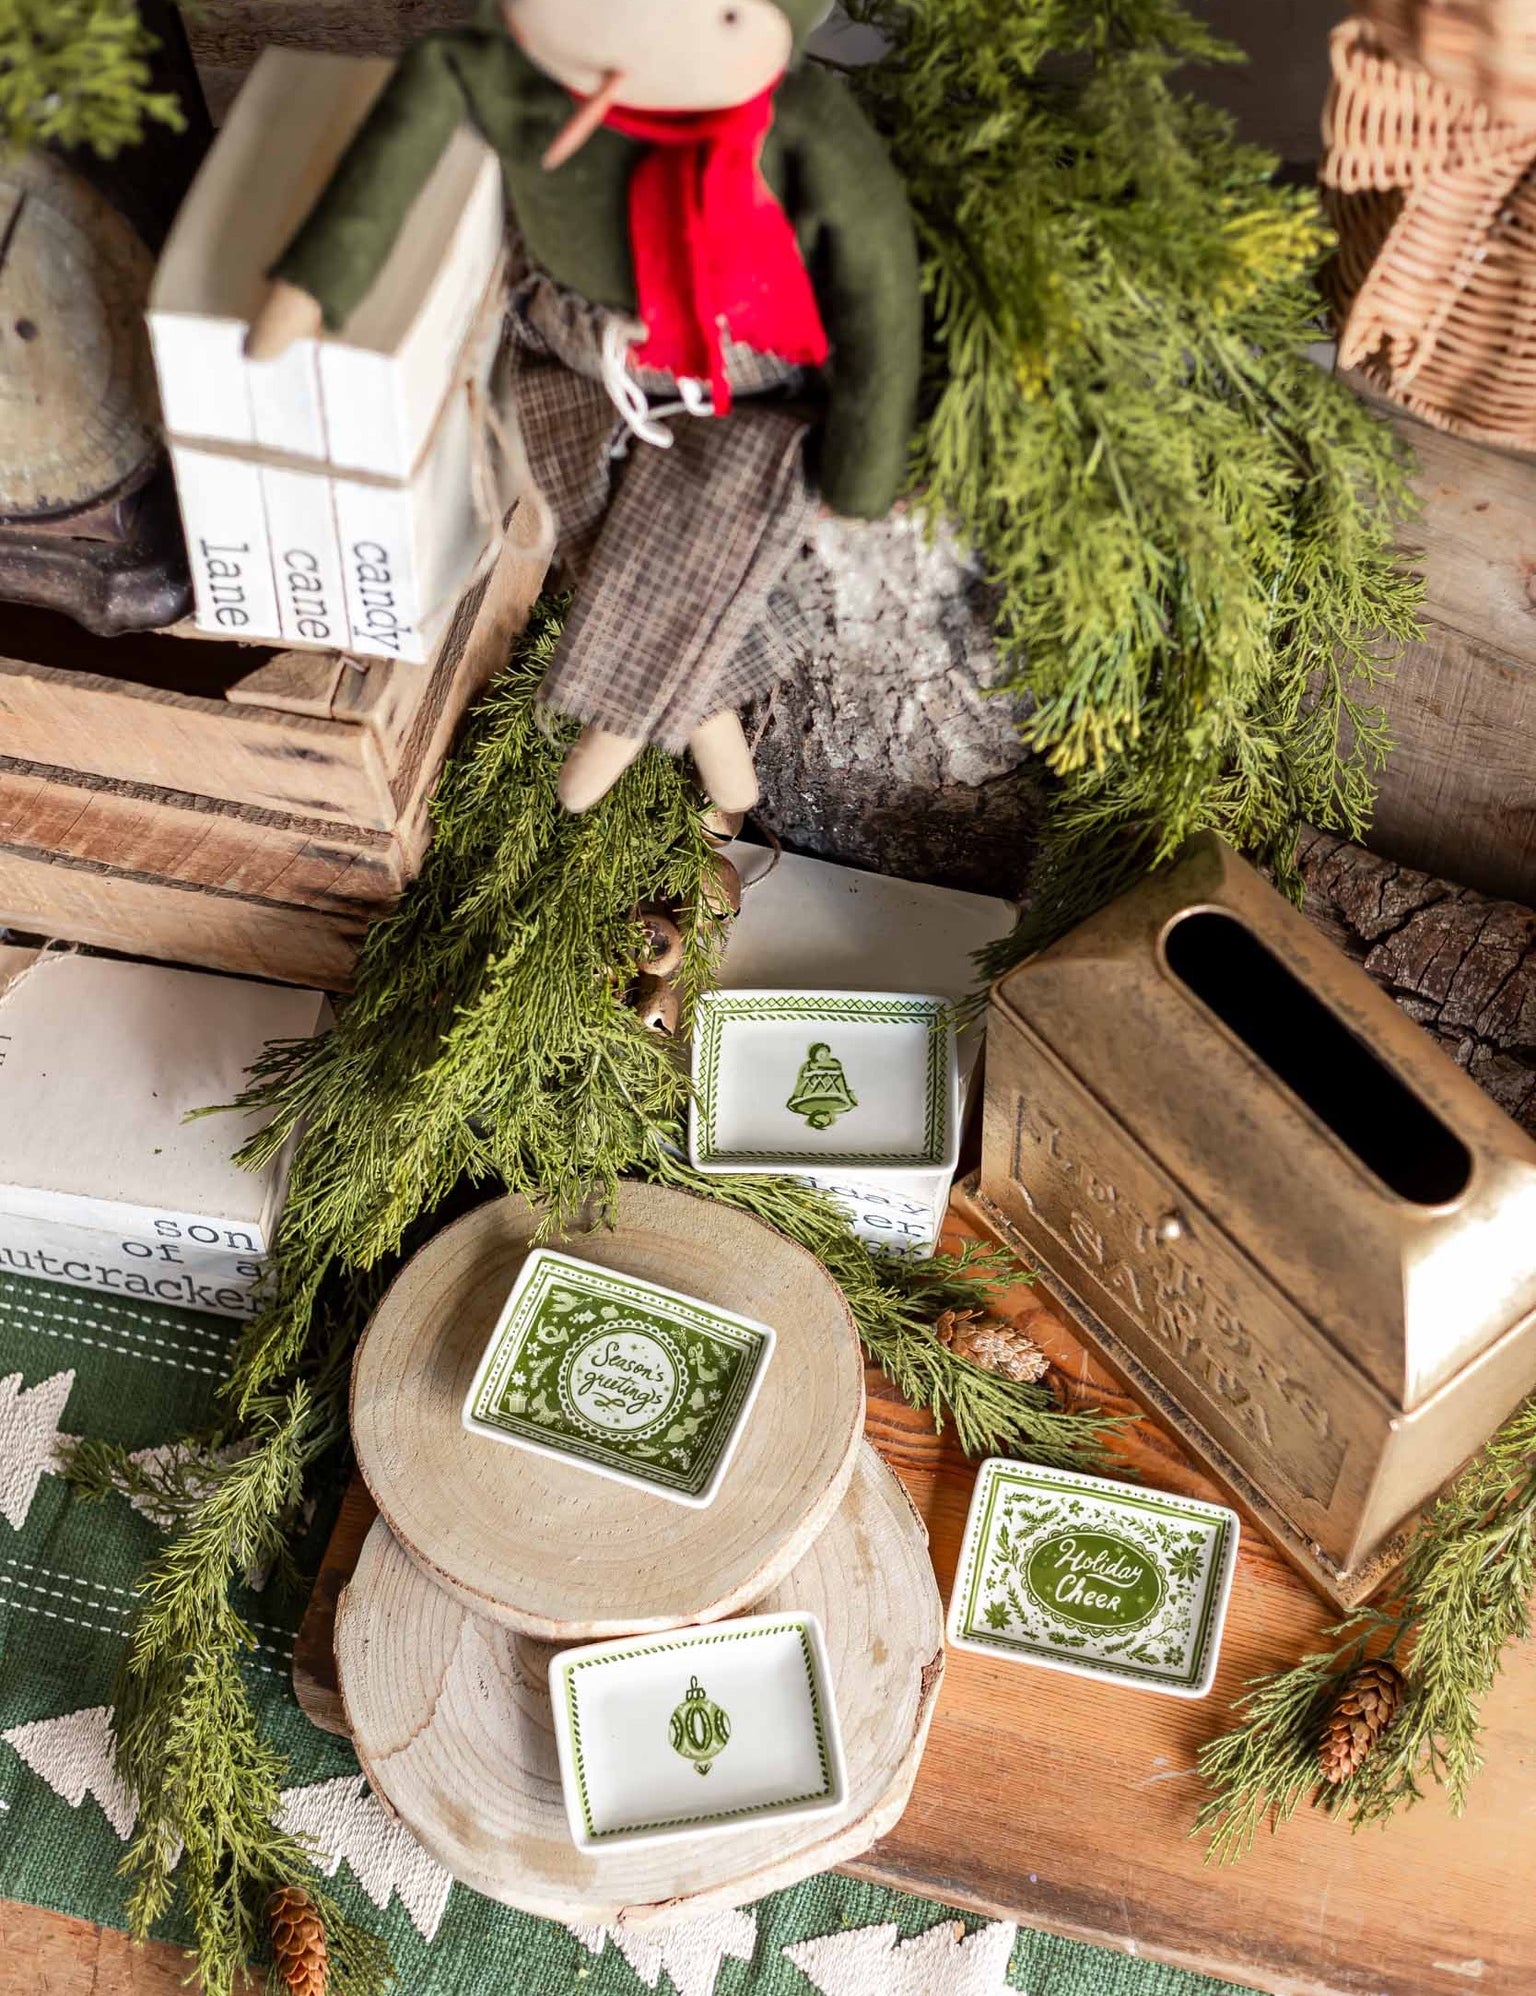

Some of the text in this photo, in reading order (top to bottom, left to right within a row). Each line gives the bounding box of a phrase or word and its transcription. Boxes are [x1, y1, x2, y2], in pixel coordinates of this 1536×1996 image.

[199, 538, 250, 627] lane
[284, 549, 330, 640] cane
[353, 540, 411, 651] candy
[121, 1240, 184, 1264] of
[154, 1219, 258, 1251] son
[0, 1246, 268, 1314] utcracker
[1036, 1112, 1330, 1440] LETTERS
[591, 1341, 664, 1382] Season's
[1070, 1210, 1274, 1447] SANTA
[578, 1372, 663, 1414] greetings
[1054, 1538, 1143, 1588] Holiday
